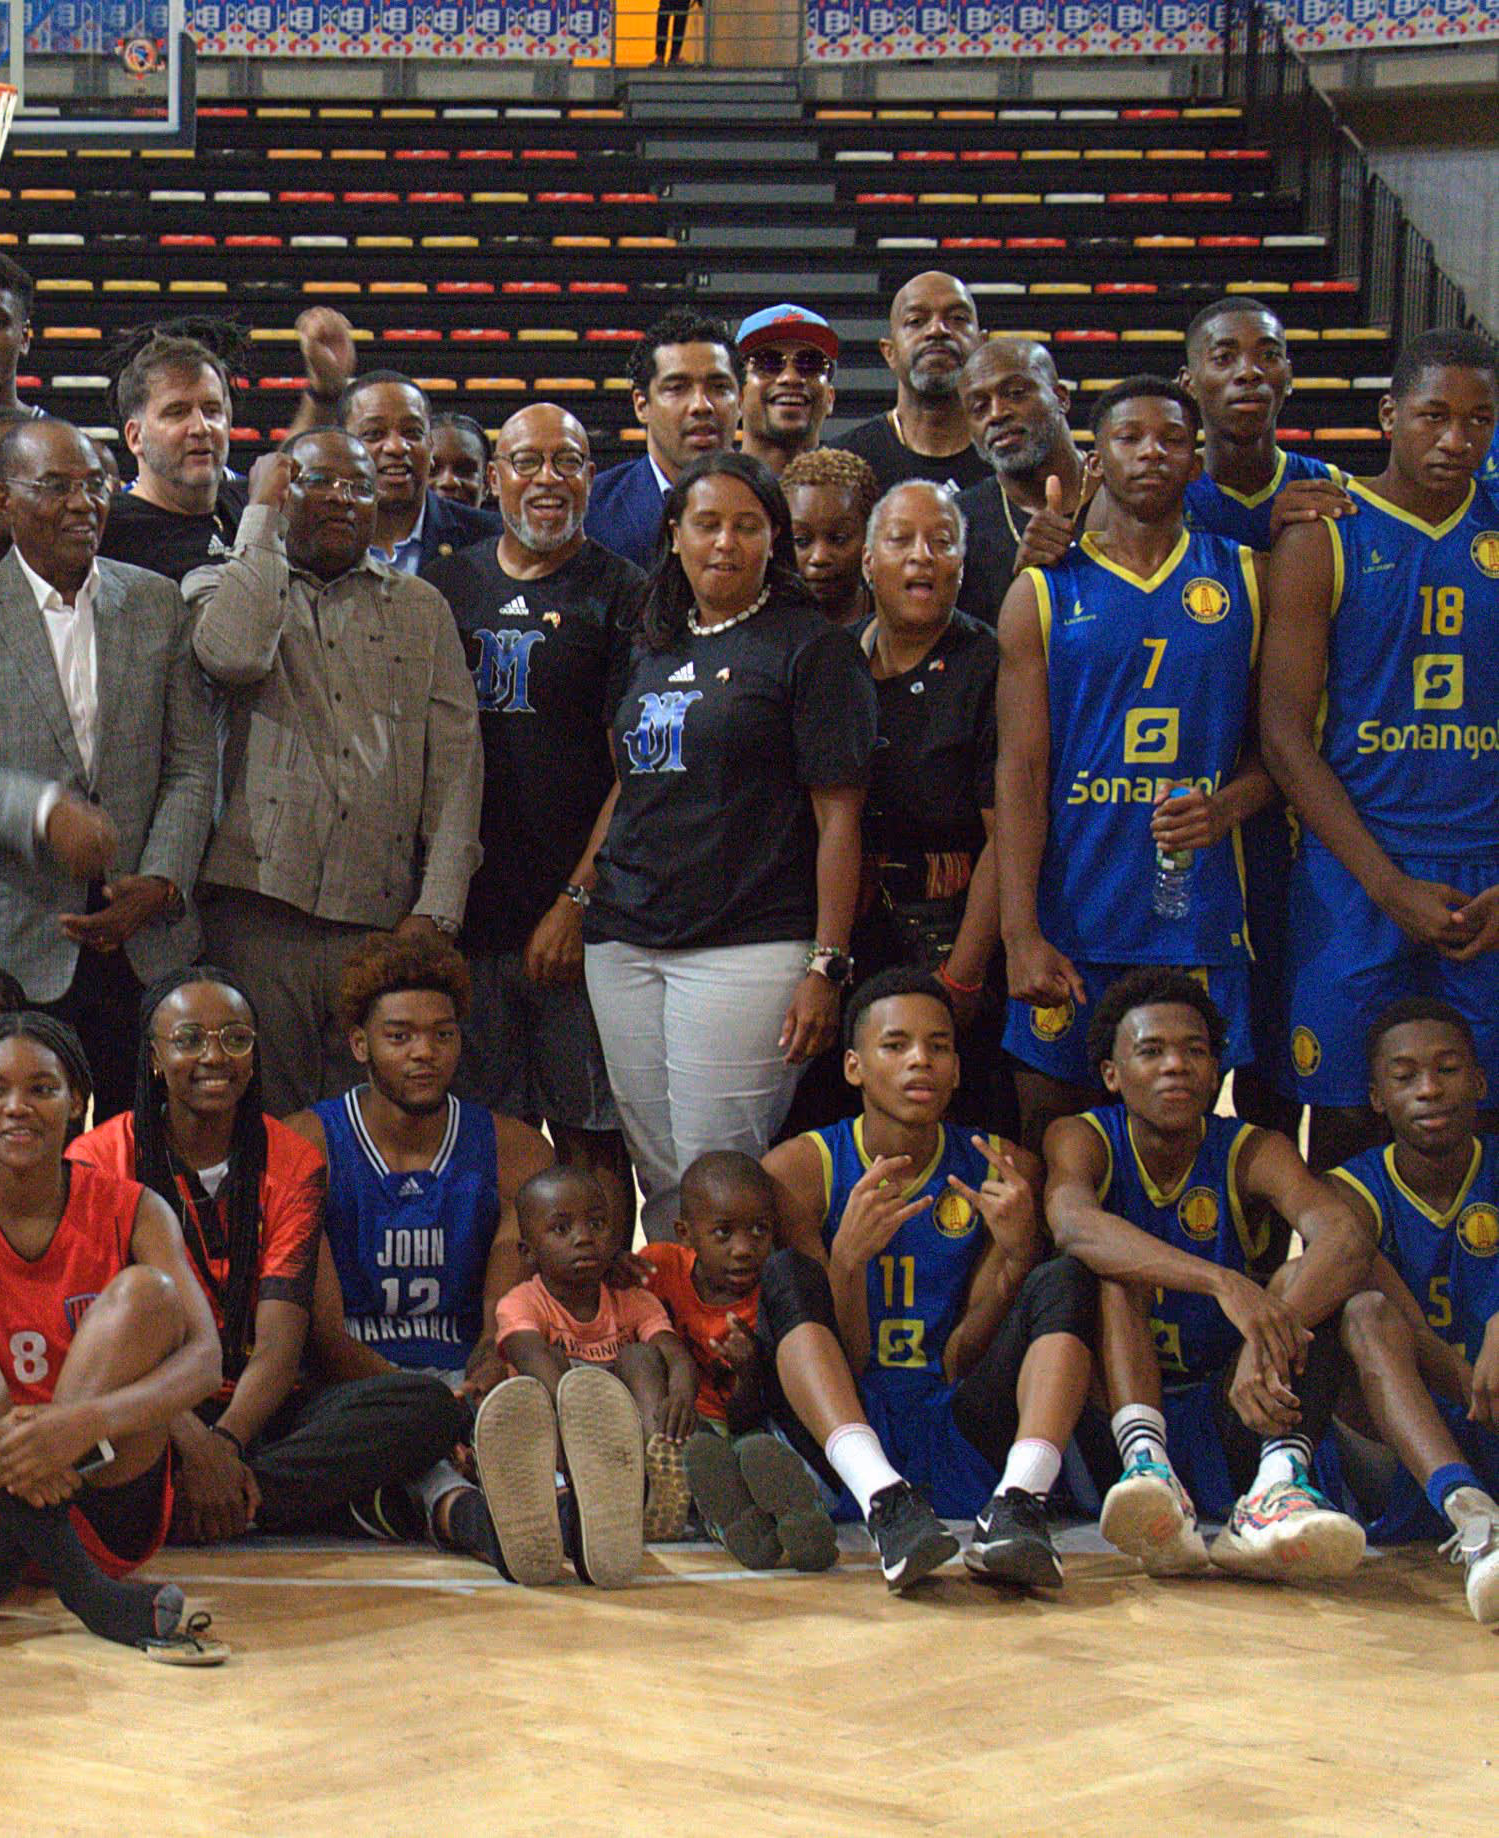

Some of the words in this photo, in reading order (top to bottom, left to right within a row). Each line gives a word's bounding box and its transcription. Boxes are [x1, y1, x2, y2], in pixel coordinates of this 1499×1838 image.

[1419, 586, 1464, 636] 18
[1143, 638, 1167, 688] 7
[1067, 770, 1222, 804] Sonaol
[377, 1228, 444, 1267] JOHN
[381, 1277, 441, 1316] 12
[879, 1255, 915, 1307] 11
[1429, 1276, 1452, 1327] 5
[344, 1315, 462, 1343] MARSHALL
[9, 1330, 49, 1384] 8
